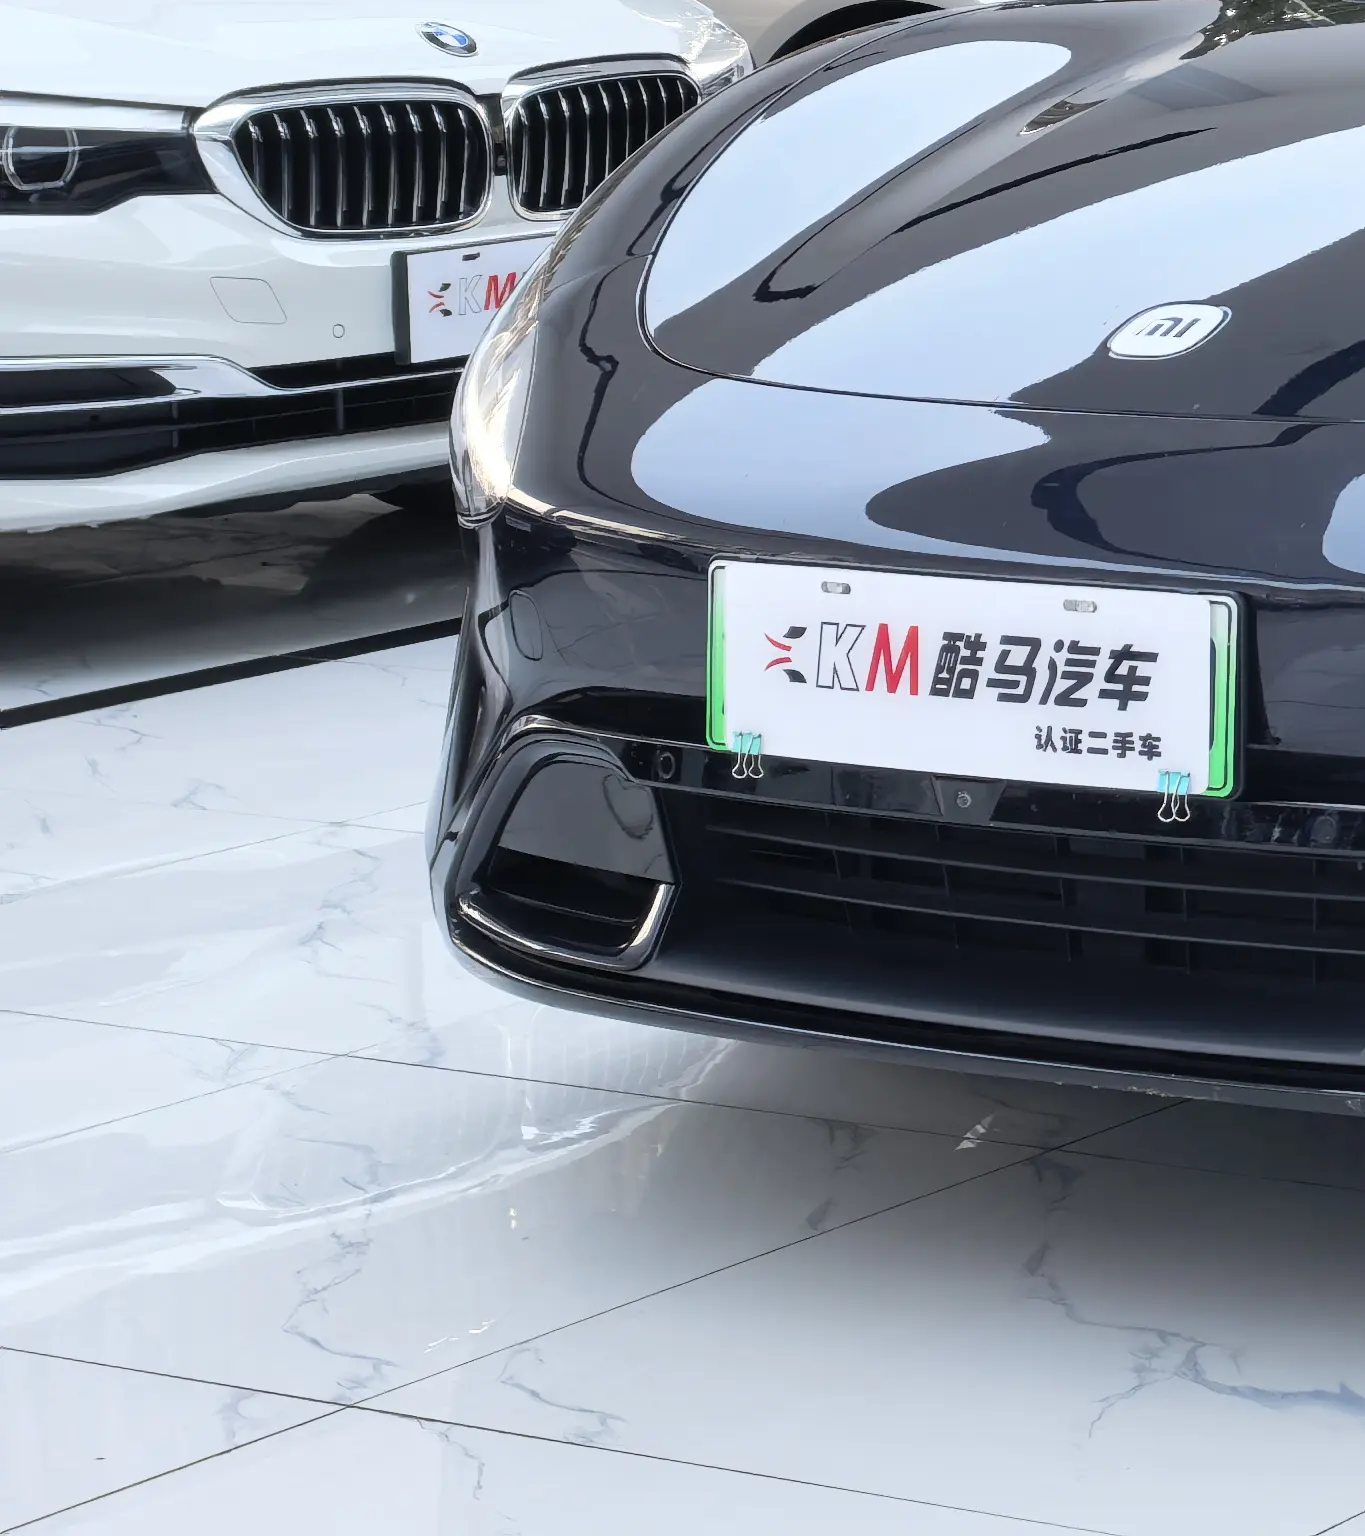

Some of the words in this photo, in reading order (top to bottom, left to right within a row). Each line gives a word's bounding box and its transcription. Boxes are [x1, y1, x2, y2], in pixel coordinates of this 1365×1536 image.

[1034, 726, 1162, 762] 认证二手车
